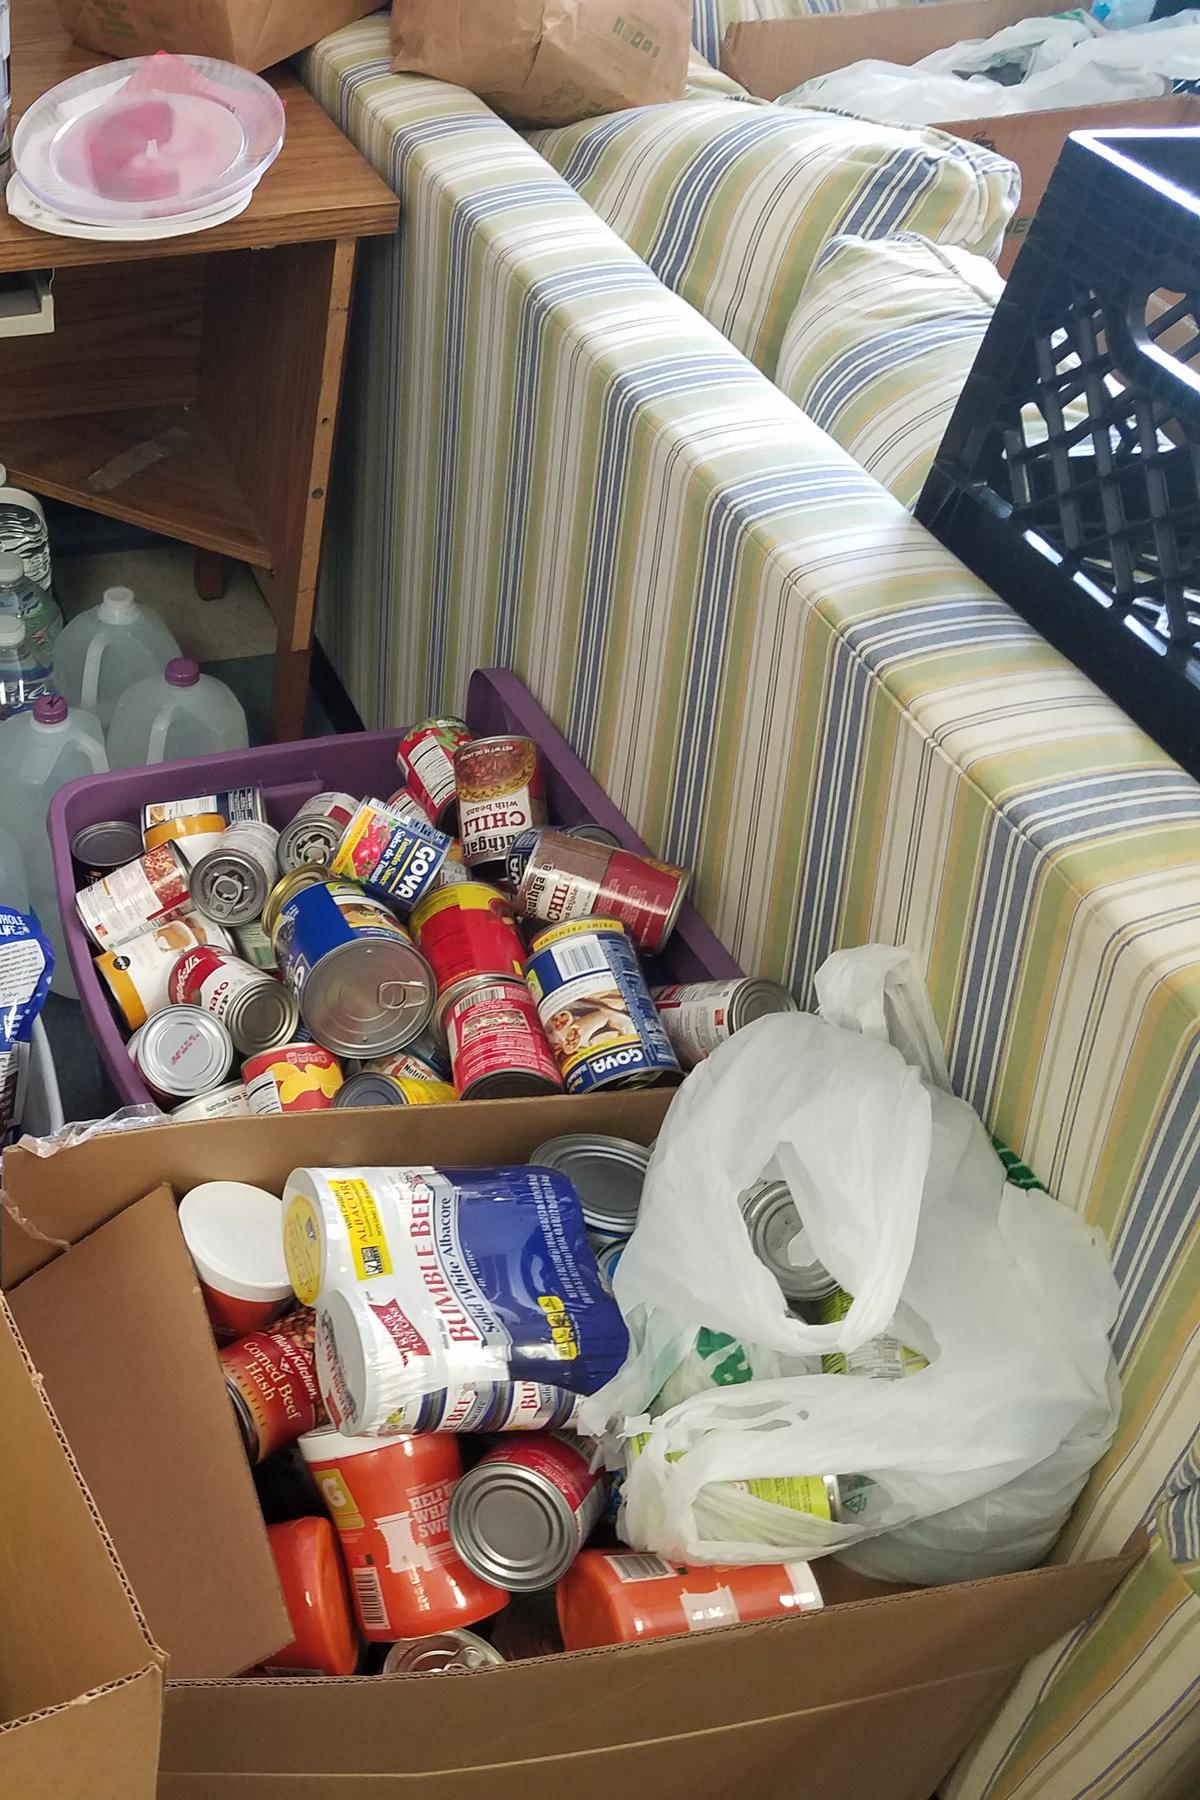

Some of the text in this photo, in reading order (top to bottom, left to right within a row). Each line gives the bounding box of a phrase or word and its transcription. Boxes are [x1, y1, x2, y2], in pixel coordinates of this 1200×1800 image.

[463, 810, 526, 838] CHILI
[466, 800, 518, 816] with beans
[369, 828, 407, 884] Salsa de Tomate
[379, 837, 413, 886] Tomato Sauce
[395, 846, 436, 899] GOYA
[546, 880, 570, 922] CHIL
[592, 1048, 644, 1074] GOYA
[340, 1179, 368, 1243] ALBACORE
[410, 1190, 480, 1342] BUMBLE BEE
[438, 1197, 499, 1333] Solid White Albacore
[388, 1306, 410, 1329] CANS
[270, 1333, 297, 1357] Mary
[243, 1341, 302, 1420] Corned Beef
[244, 1360, 277, 1402] Hash
